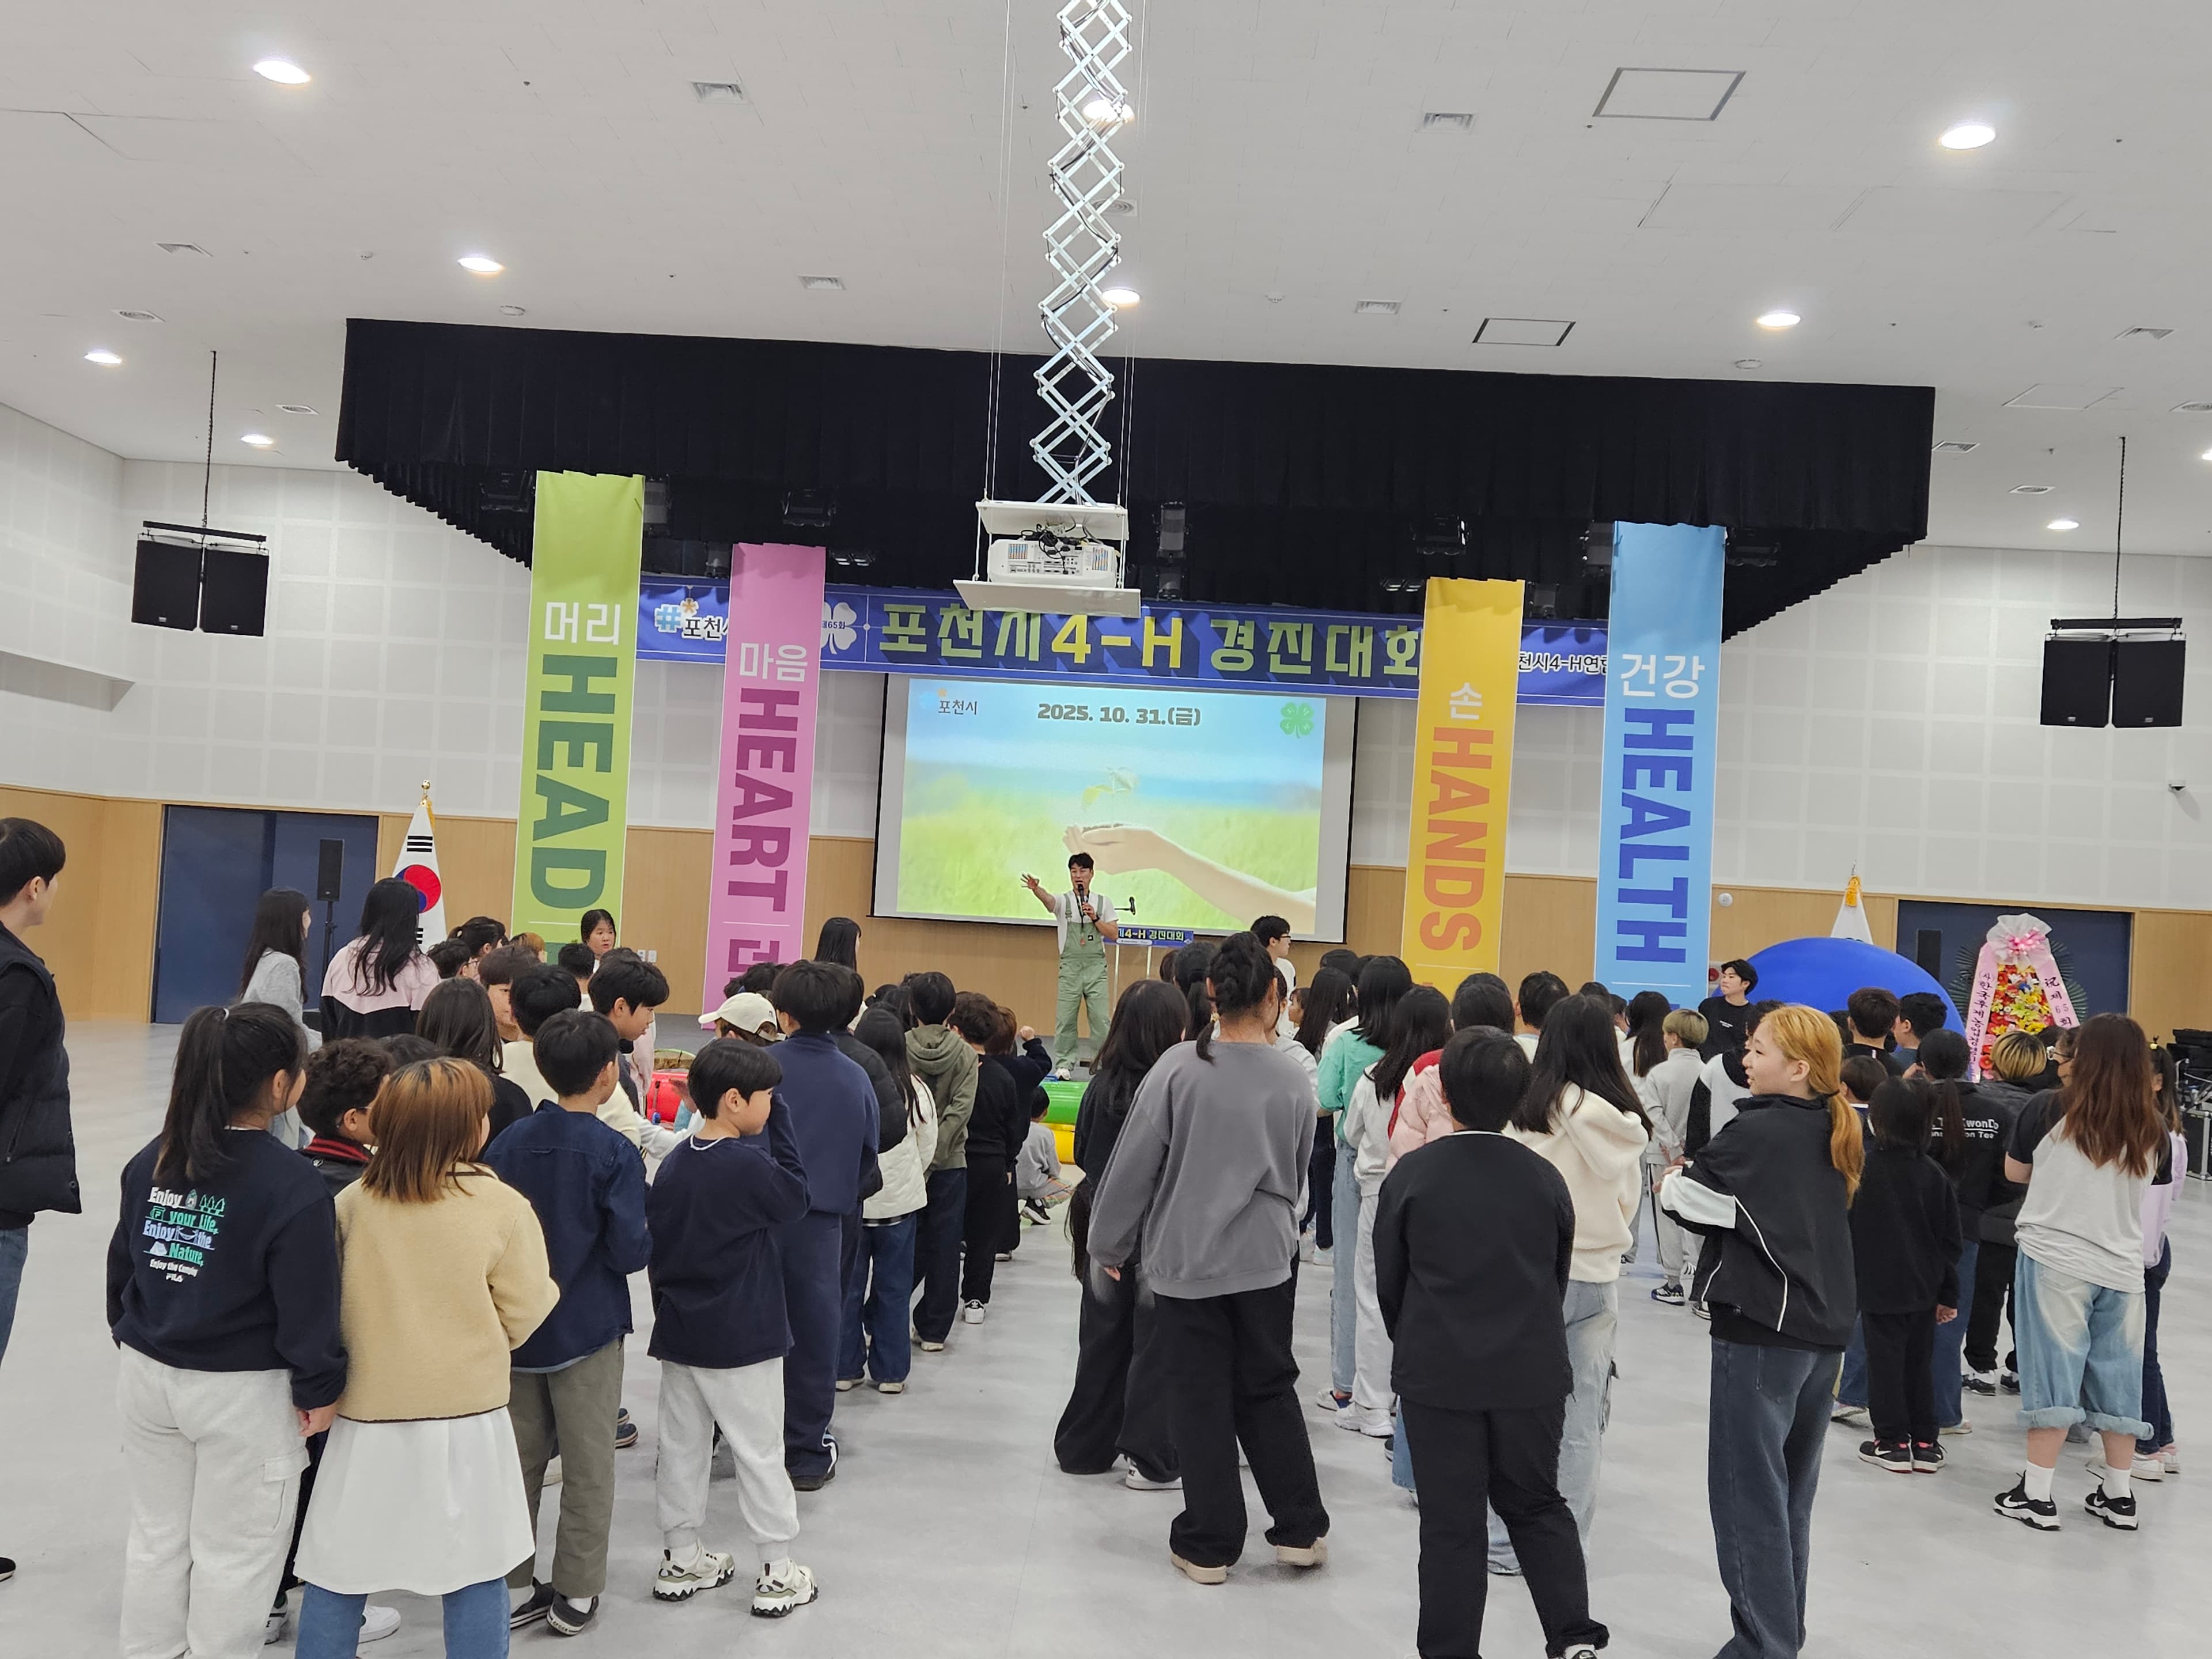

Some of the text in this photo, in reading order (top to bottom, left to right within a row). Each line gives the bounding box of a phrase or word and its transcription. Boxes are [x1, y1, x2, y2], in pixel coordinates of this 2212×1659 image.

[544, 601, 621, 645] 머리
[739, 642, 808, 683] 마음
[1620, 653, 1705, 699] 건강
[938, 699, 978, 715] 포천시
[1037, 703, 1200, 726] 2025. 10. 31.(금)
[1449, 682, 1483, 720] 손
[530, 654, 618, 909] HEAD
[728, 688, 800, 912] HEART
[1419, 726, 1494, 951] HANDS
[1616, 707, 1695, 963] HEALTH
[149, 1187, 183, 1209] Enjoy
[143, 1219, 212, 1248] Enjoy the
[168, 1211, 196, 1227] your
[150, 1259, 167, 1270] Enjoy
[166, 1272, 184, 1282] FILA
